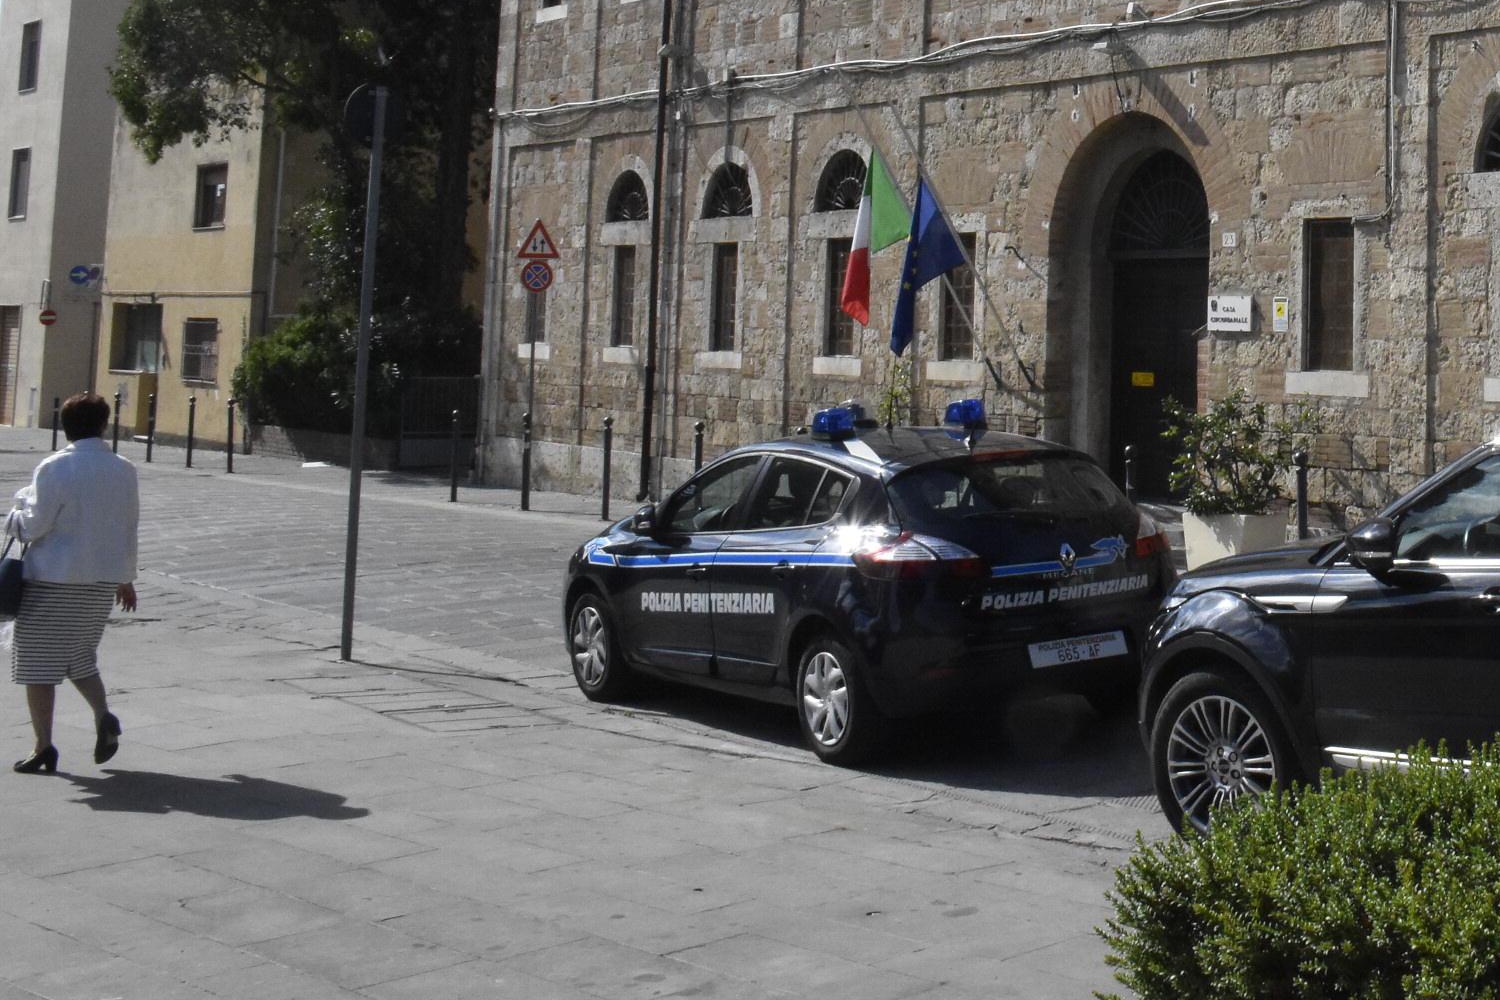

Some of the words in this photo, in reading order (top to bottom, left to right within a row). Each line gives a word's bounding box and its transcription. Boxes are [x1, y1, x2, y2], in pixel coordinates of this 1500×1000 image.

[641, 591, 682, 612] POLIZIA
[683, 592, 775, 614] PENITENZIARIA
[981, 590, 1044, 610] POLIZIA
[1048, 574, 1148, 602] PENITENZIARIA
